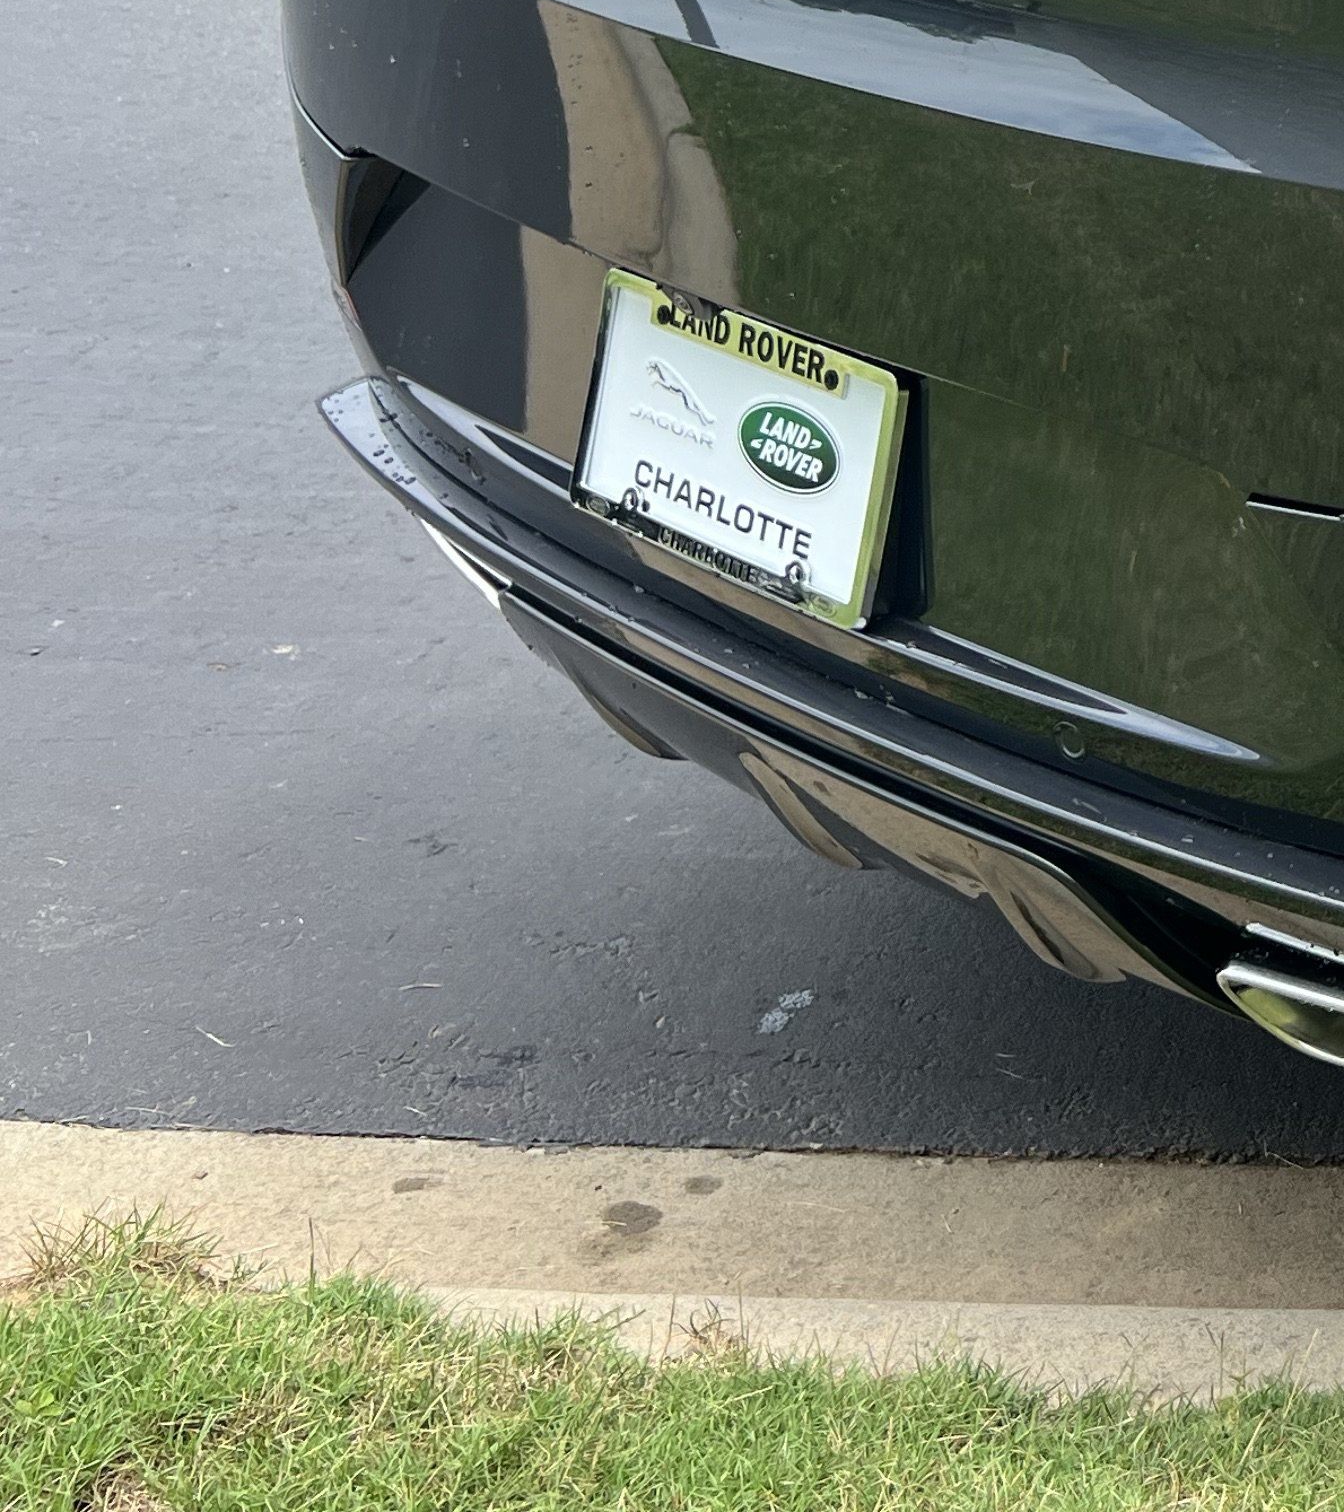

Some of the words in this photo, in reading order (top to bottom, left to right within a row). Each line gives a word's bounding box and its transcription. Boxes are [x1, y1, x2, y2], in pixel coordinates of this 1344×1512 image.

[669, 301, 731, 345] LAND
[738, 322, 825, 385] ROVER
[630, 407, 715, 449] JAGUAR
[759, 411, 812, 448] LAND
[758, 441, 824, 483] ROVER
[634, 459, 812, 560] CHARLOTTE
